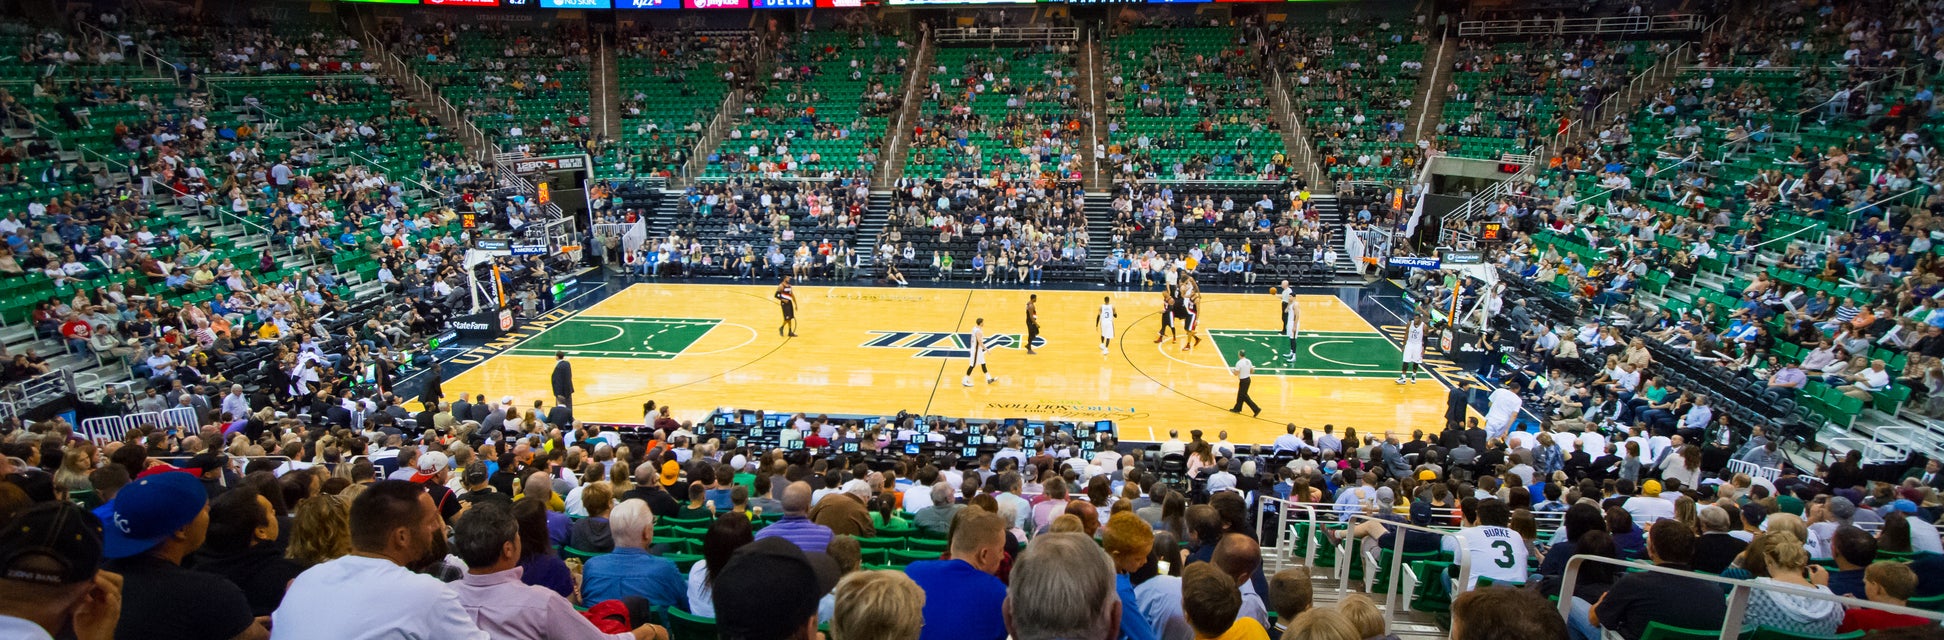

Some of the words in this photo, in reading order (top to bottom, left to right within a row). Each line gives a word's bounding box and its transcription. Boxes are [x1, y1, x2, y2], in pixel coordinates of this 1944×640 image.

[516, 161, 543, 169] 1280
[1416, 259, 1436, 267] FIRST
[114, 511, 131, 533] KC
[1483, 528, 1511, 538] BURKE
[1491, 540, 1515, 568] 3
